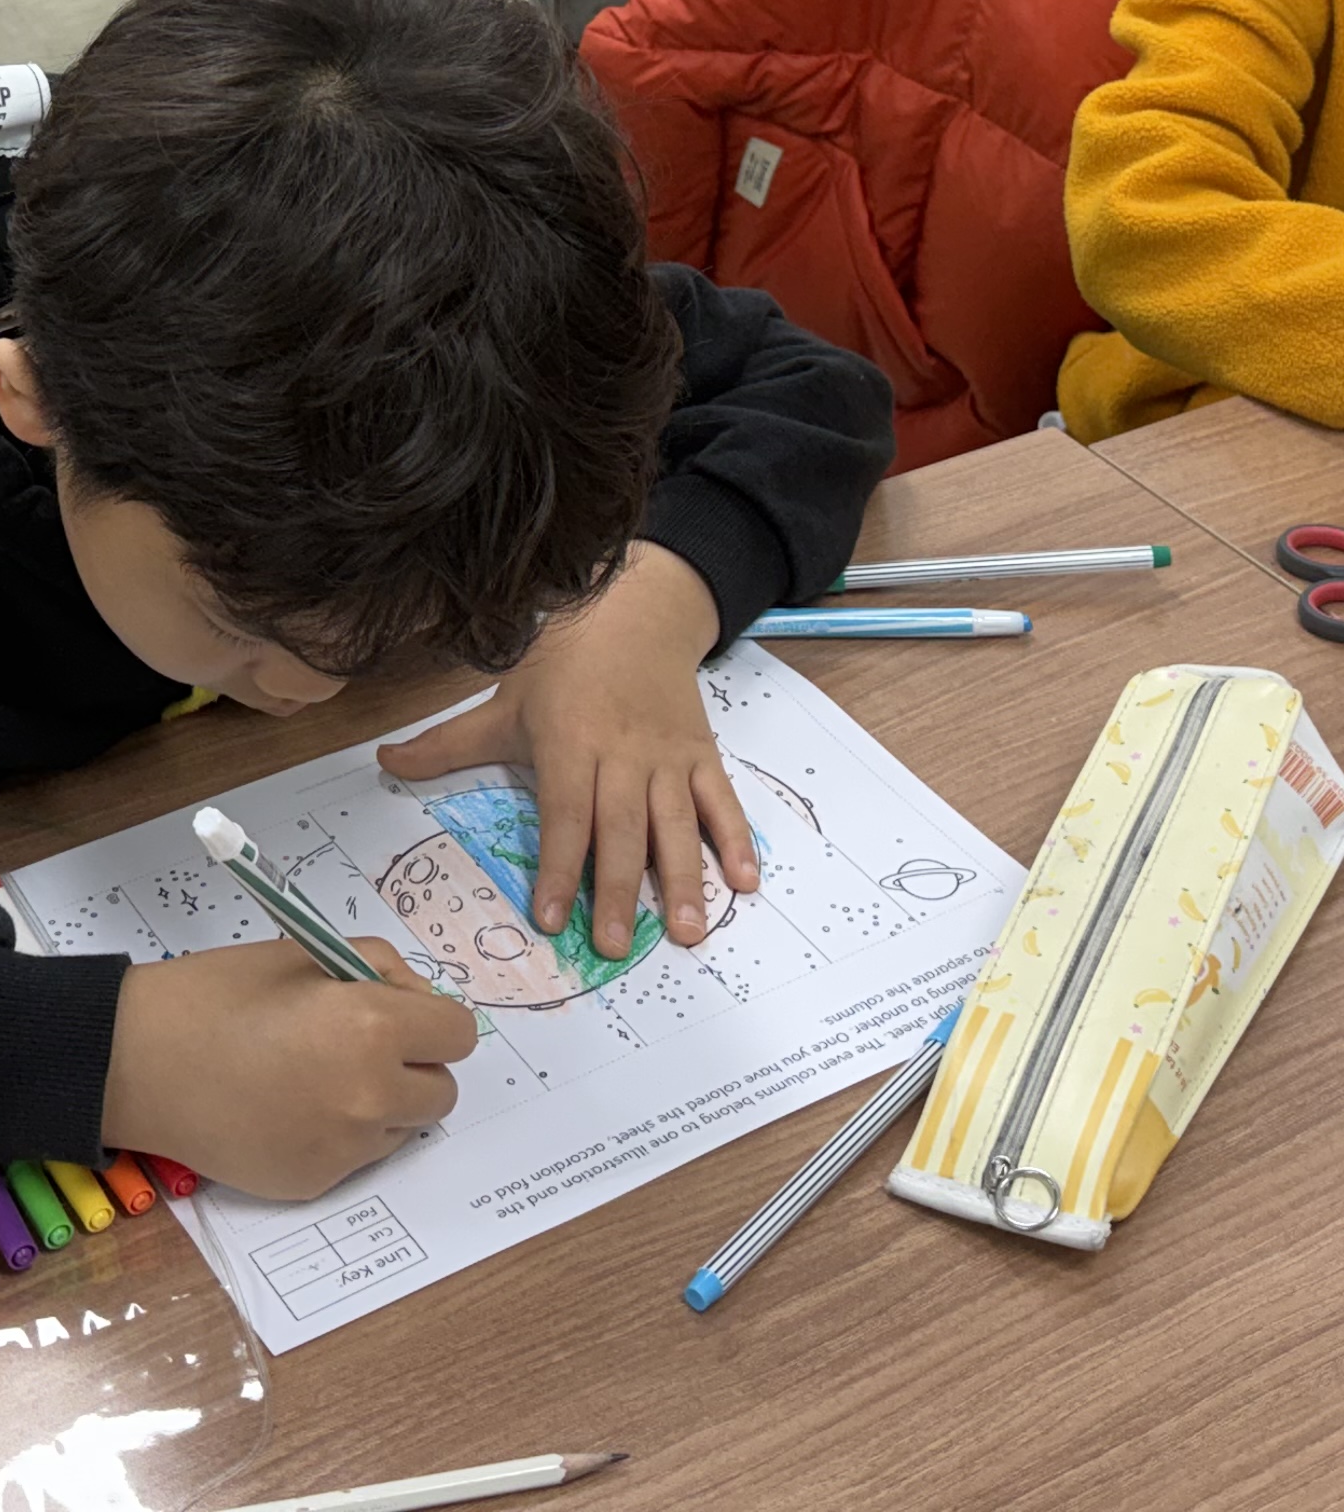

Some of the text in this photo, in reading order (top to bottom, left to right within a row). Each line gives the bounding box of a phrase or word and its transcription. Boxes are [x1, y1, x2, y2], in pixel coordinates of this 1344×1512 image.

[821, 947, 990, 1025] to separate the columns.
[911, 996, 929, 1006] to
[856, 1004, 908, 1034] another.
[885, 1017, 927, 1038] sheet.
[812, 1033, 850, 1052] Once
[856, 1038, 885, 1053] The
[781, 1047, 810, 1066] you
[819, 1051, 854, 1070] even
[744, 1064, 782, 1083] have
[755, 1068, 816, 1099] columns
[686, 1082, 741, 1112] colored
[658, 1108, 685, 1122] the
[699, 1097, 755, 1124] belong
[608, 1120, 655, 1144] sheet,
[682, 1122, 700, 1133] to
[649, 1131, 678, 1148] one
[530, 1144, 605, 1181] accordion
[562, 1146, 648, 1188] illustration
[495, 1179, 529, 1200] fold
[526, 1186, 558, 1206] and
[470, 1195, 492, 1208] on
[496, 1202, 525, 1218] the
[347, 1207, 378, 1226] Fold
[368, 1227, 393, 1242] Cut
[340, 1247, 411, 1287] Line Key:
